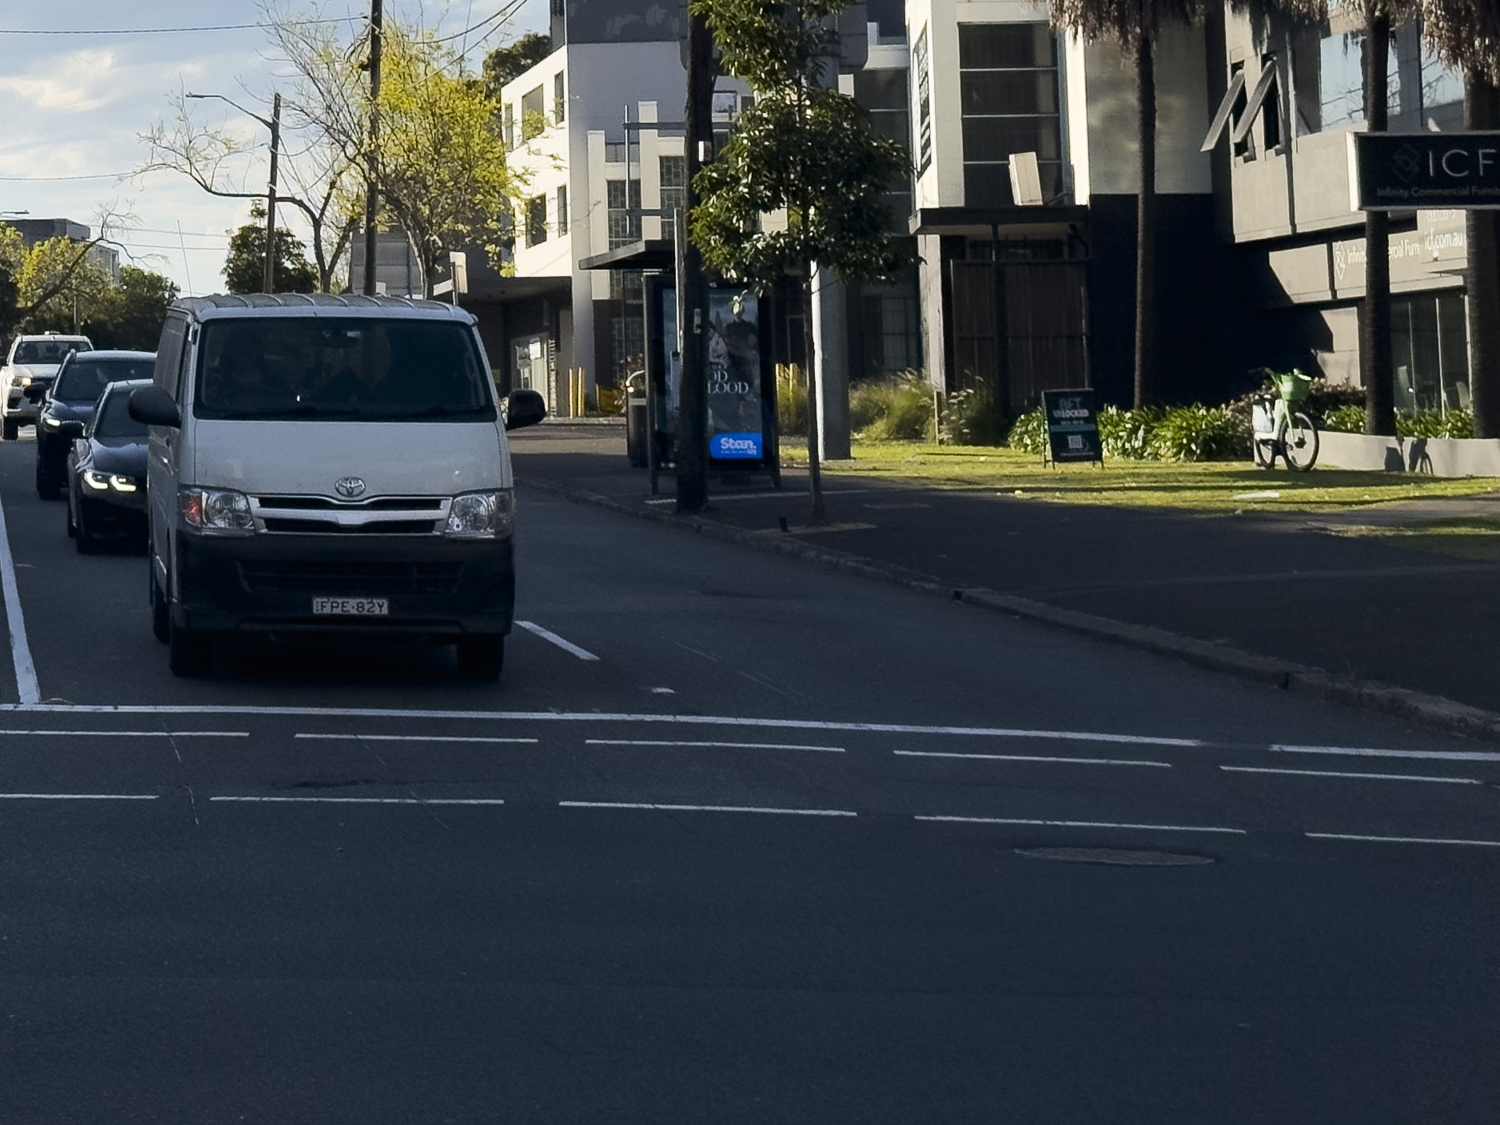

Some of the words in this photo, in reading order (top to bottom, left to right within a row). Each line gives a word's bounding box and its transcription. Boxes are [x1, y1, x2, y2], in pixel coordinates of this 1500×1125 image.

[1428, 148, 1498, 178] ICF
[1377, 186, 1409, 198] Infinity
[1411, 185, 1470, 196] Commercial
[1472, 185, 1500, 196] Furnit
